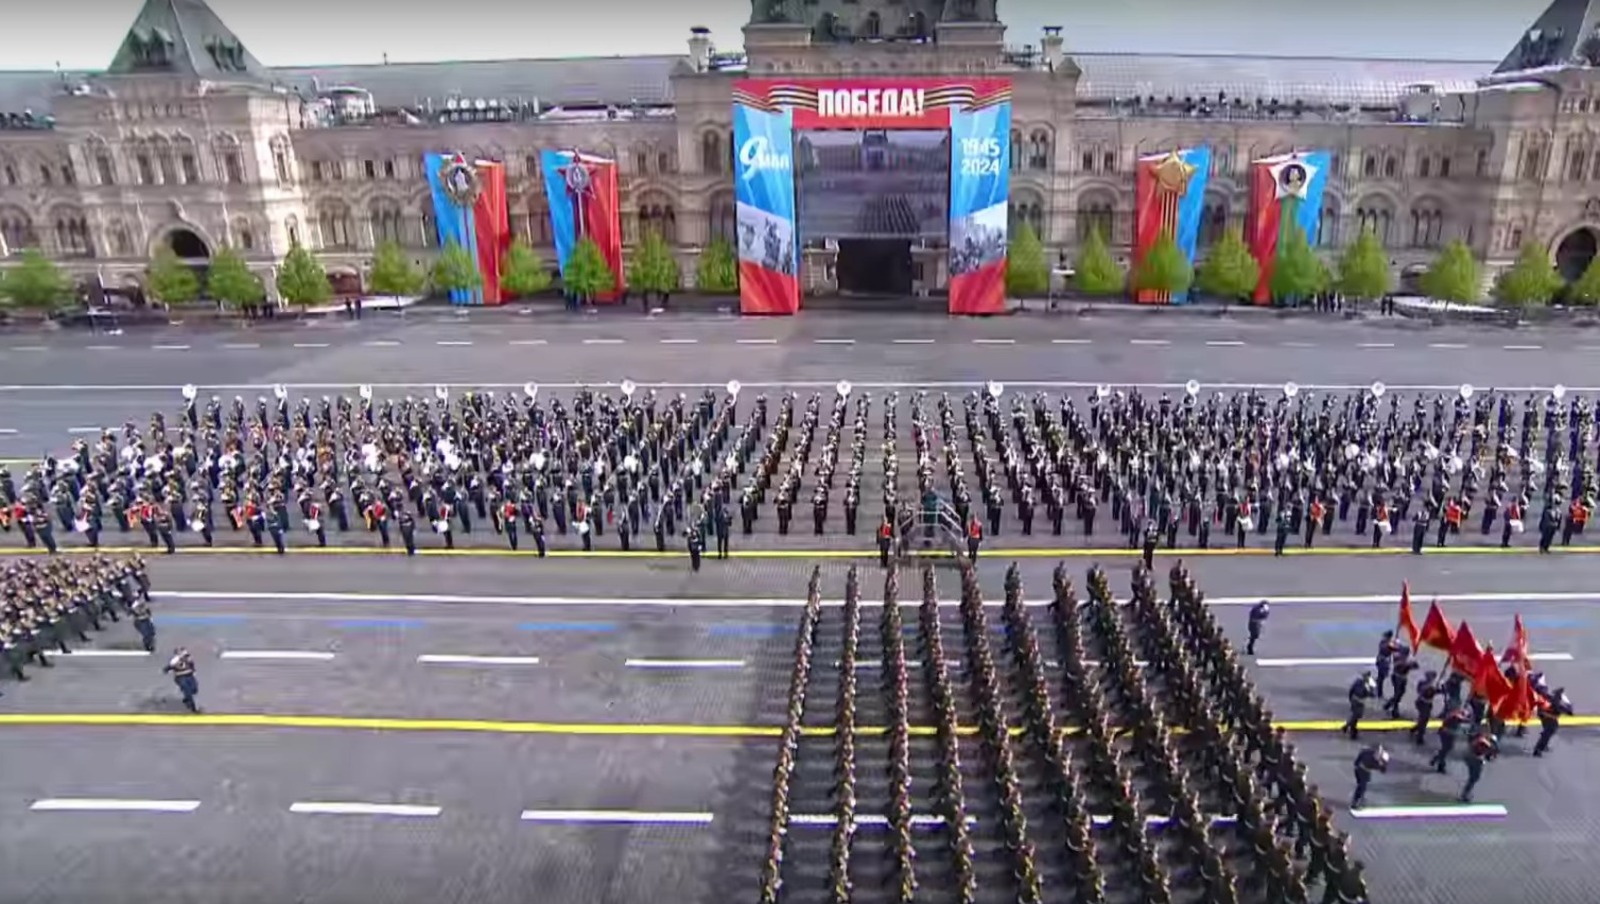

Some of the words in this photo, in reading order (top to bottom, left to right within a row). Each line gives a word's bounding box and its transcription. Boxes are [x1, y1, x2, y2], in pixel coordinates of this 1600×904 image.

[818, 88, 924, 117] ПОБЕДА!
[961, 138, 1000, 157] 1945
[961, 158, 1000, 176] 2024
